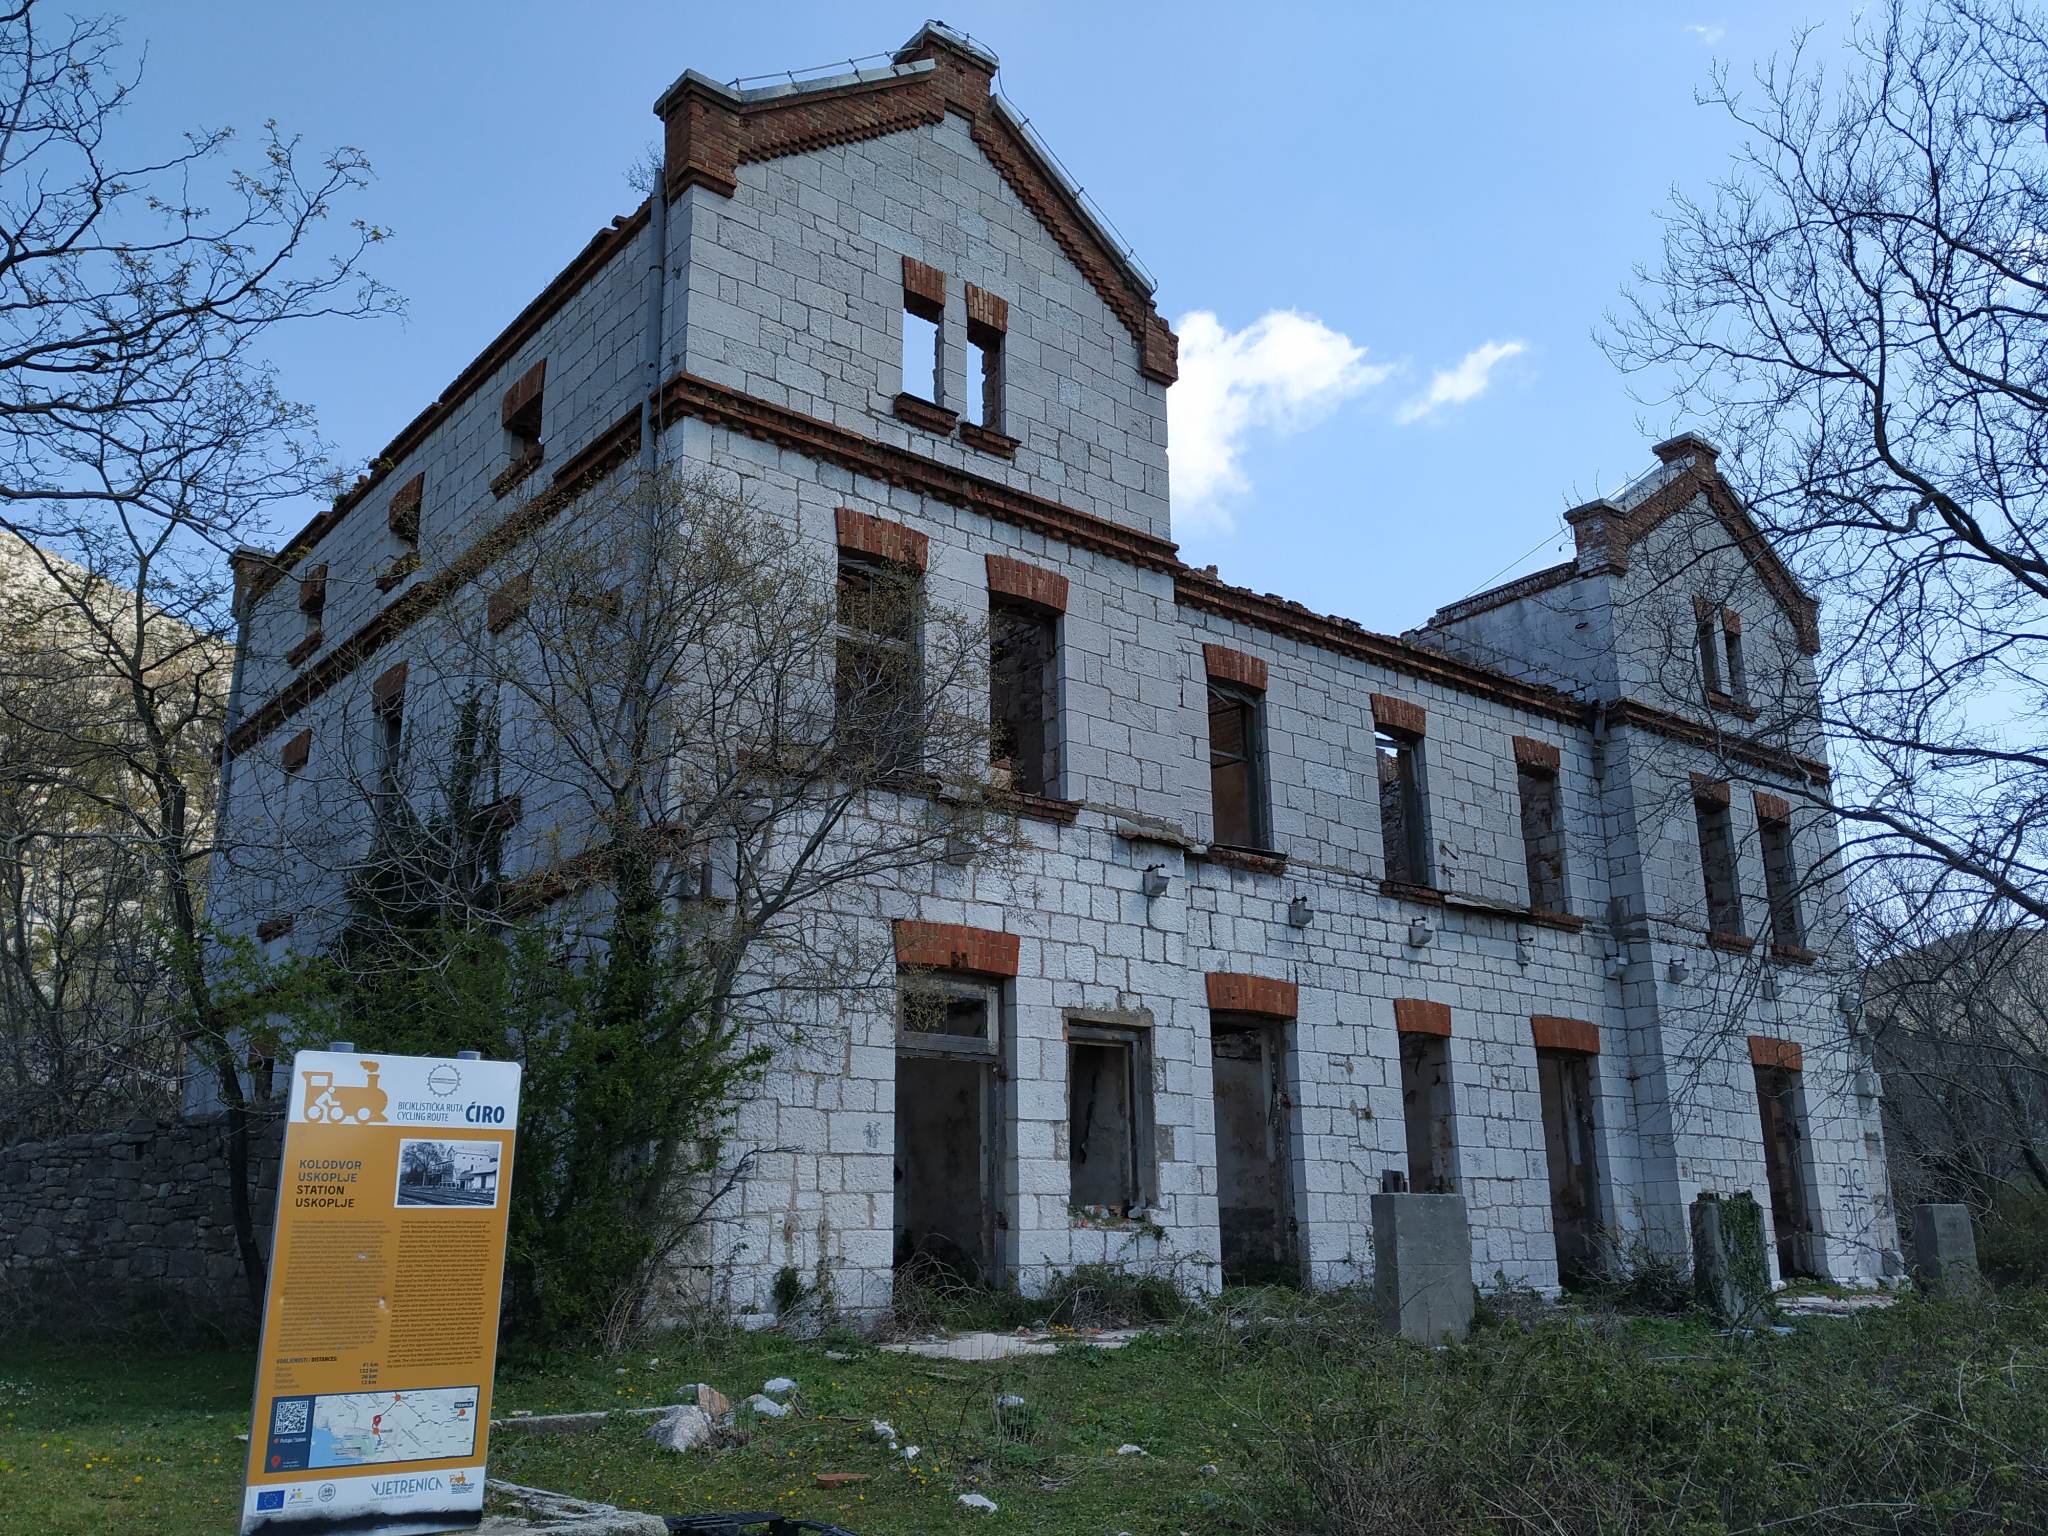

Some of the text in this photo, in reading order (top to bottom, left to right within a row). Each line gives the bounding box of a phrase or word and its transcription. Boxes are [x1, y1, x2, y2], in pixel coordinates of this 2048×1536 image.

[446, 1103, 464, 1113] RUTA
[465, 1101, 505, 1124] ĆIRO
[397, 1111, 449, 1122] CYCLING ROUTE
[299, 1159, 362, 1170] KOLODVOR
[298, 1172, 357, 1183] USKOPLJE
[296, 1184, 345, 1196] STATION
[295, 1197, 355, 1209] USKOPLJE
[371, 1477, 443, 1496] VJETRENICA
